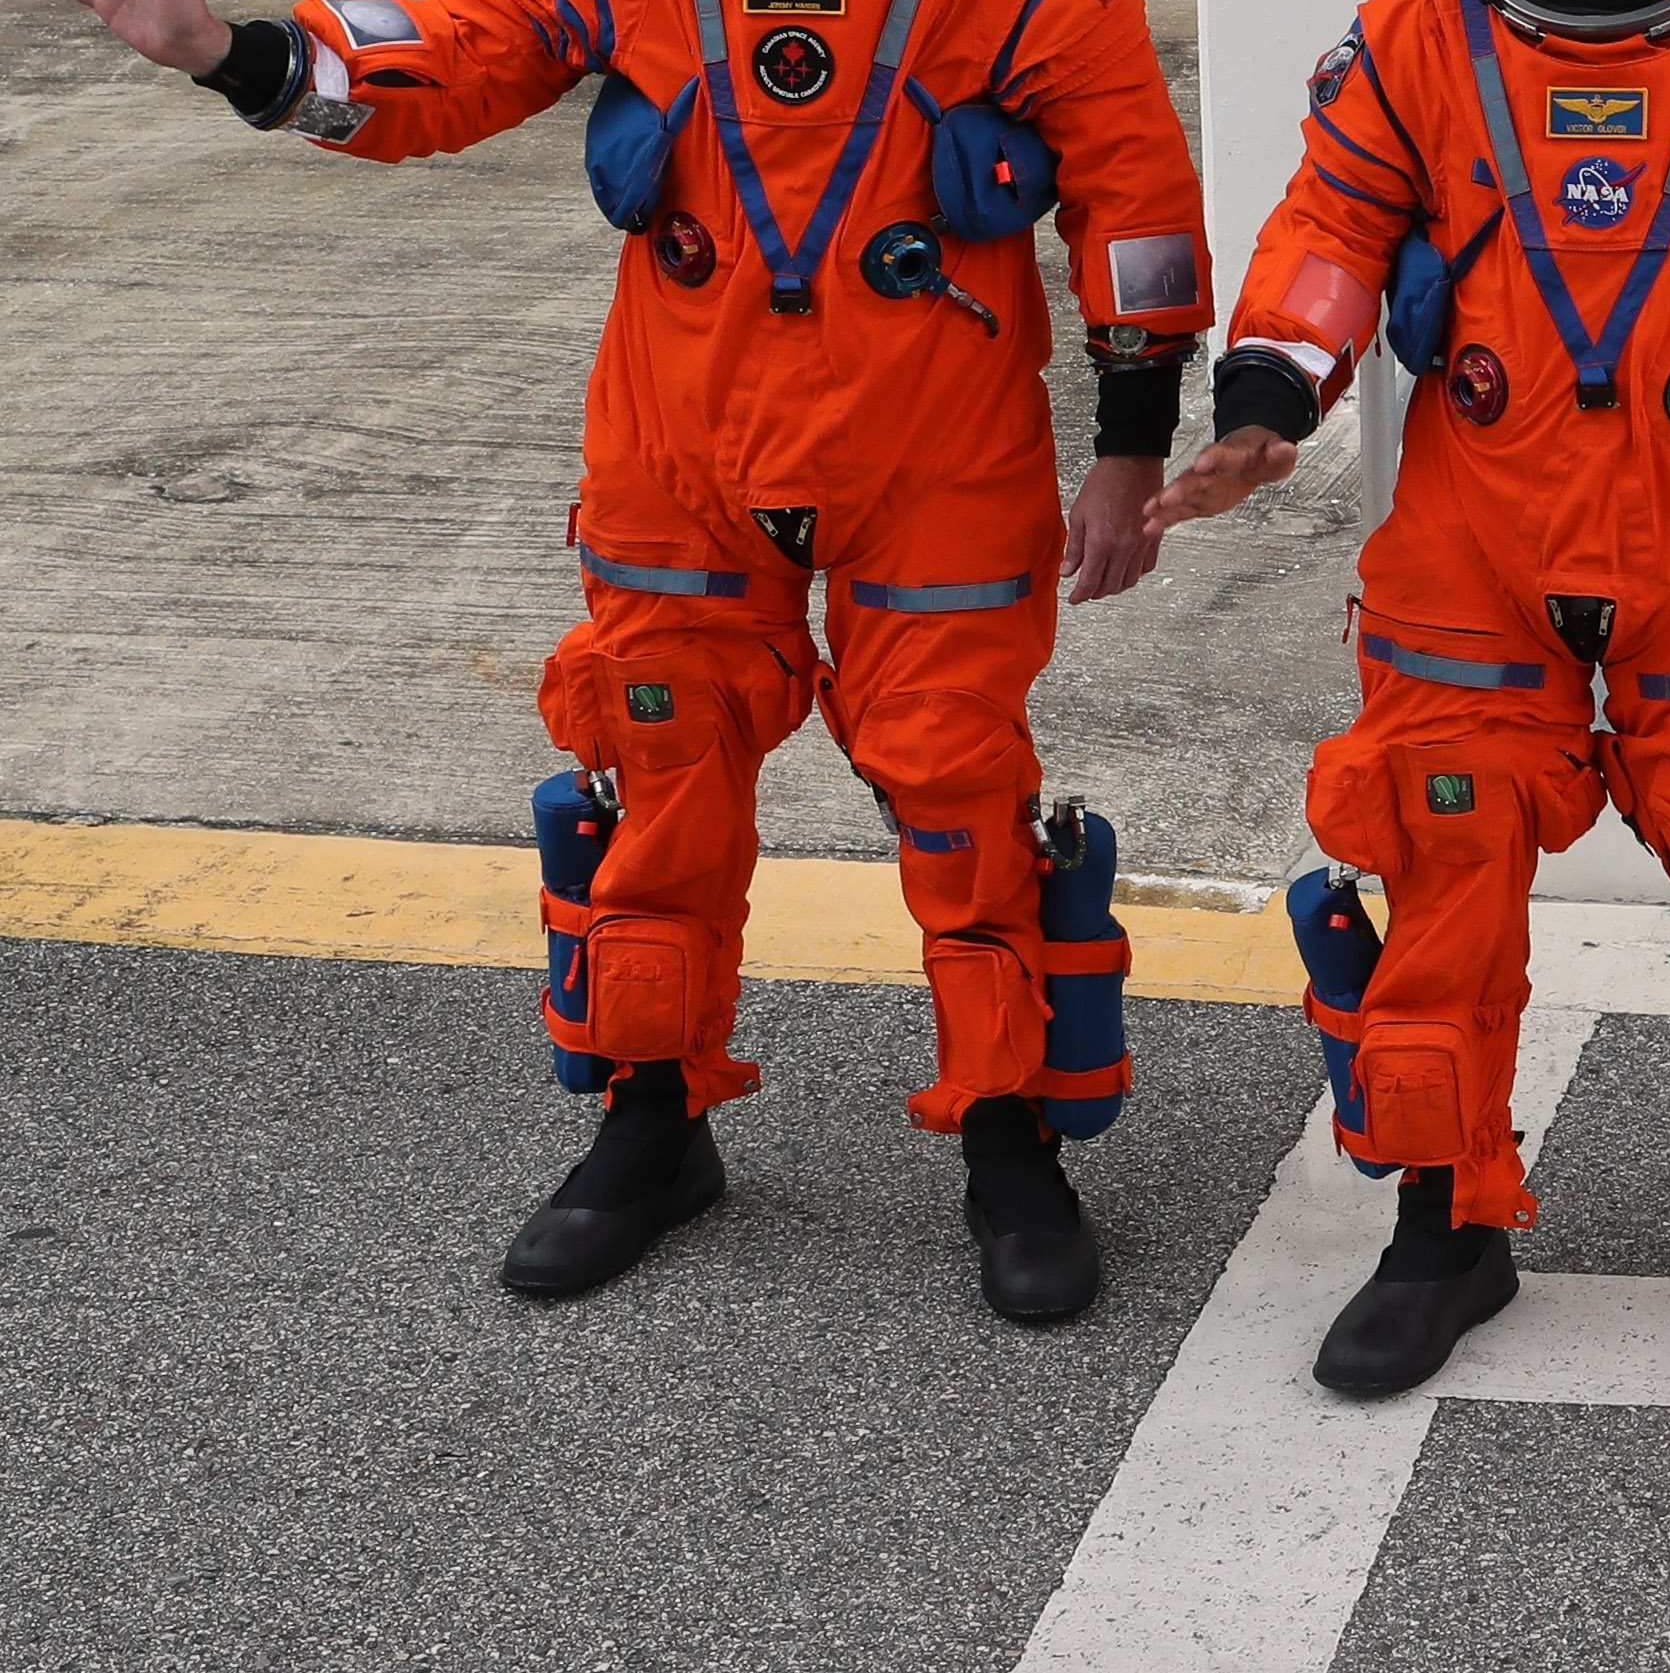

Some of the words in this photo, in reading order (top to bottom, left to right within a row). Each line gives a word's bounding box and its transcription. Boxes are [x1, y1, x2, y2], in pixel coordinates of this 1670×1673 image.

[788, 31, 807, 40] SPACE
[808, 37, 826, 58] AGENCY
[1566, 124, 1594, 133] VICTOR
[1597, 124, 1627, 133] GLOVER
[1566, 183, 1630, 203] NASA
